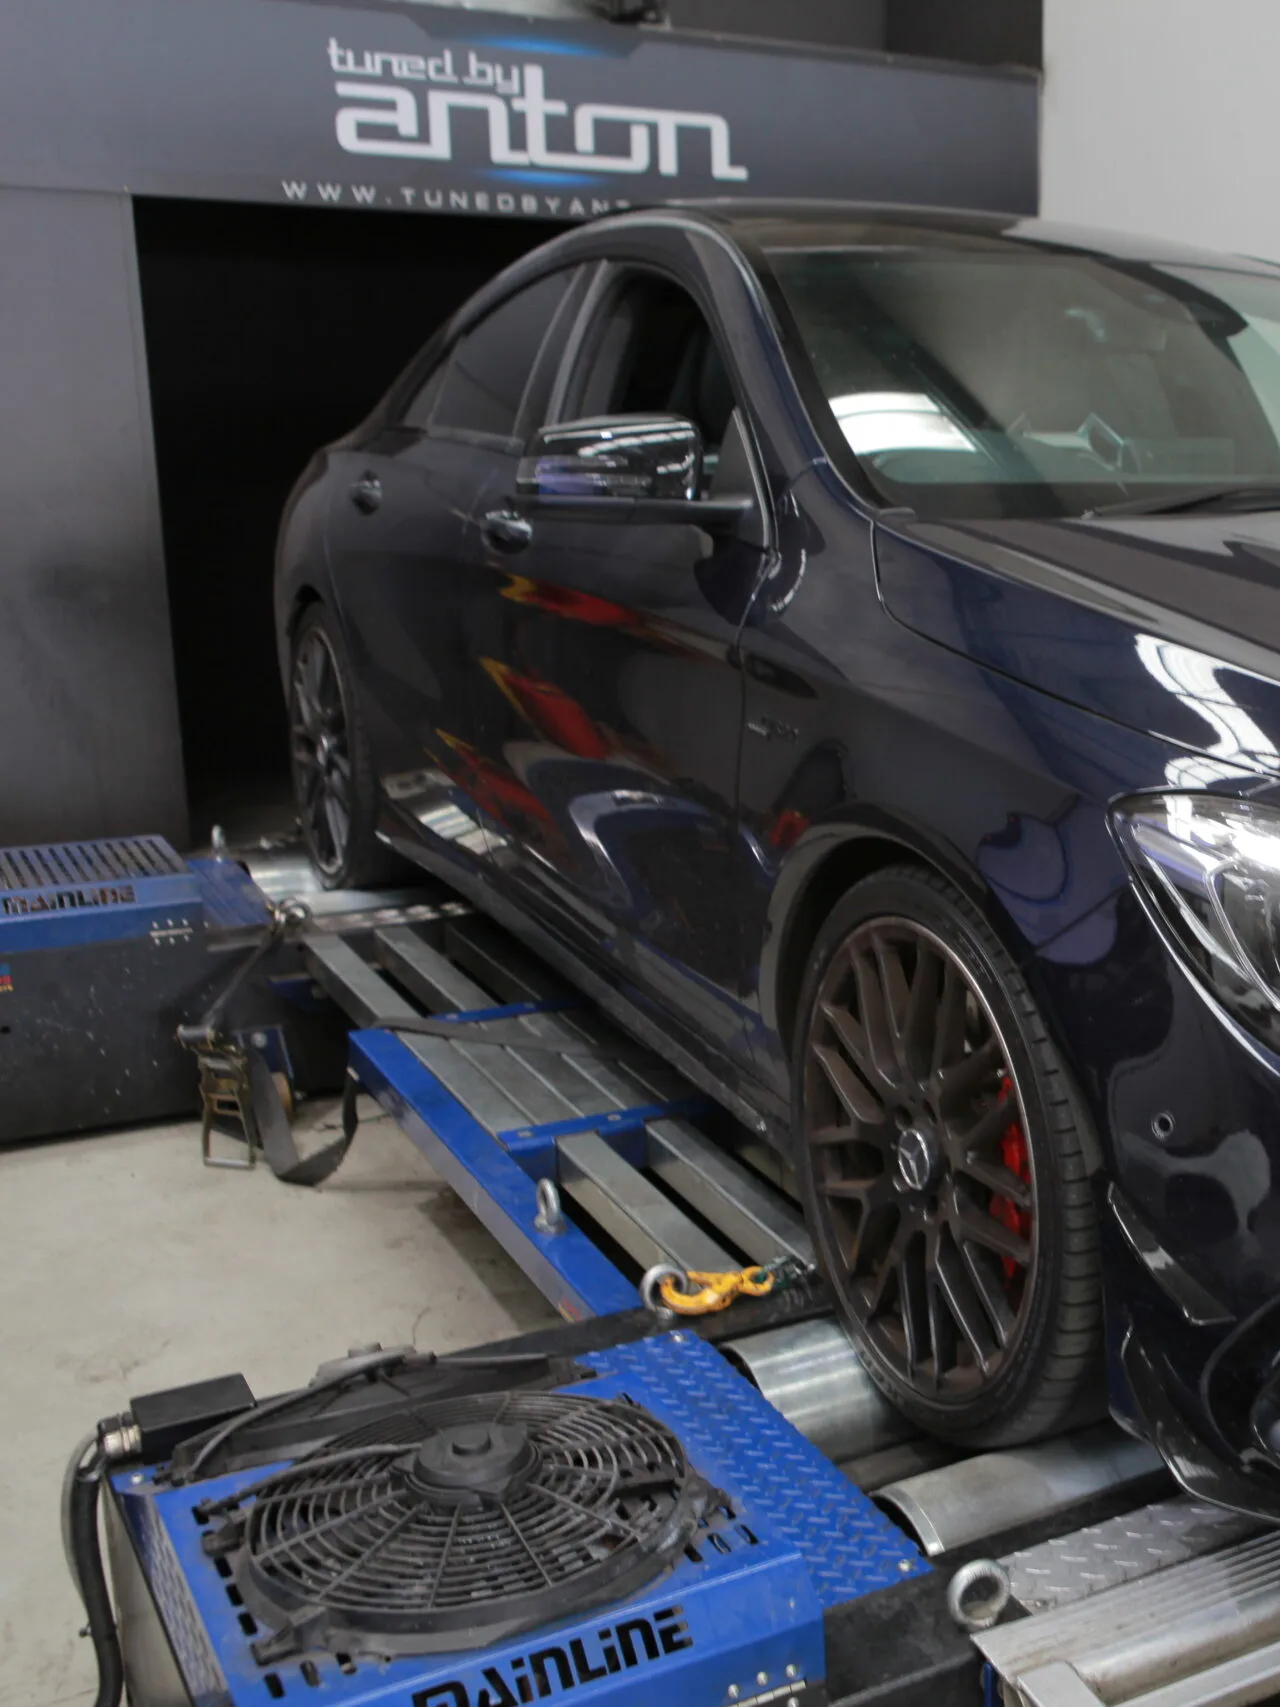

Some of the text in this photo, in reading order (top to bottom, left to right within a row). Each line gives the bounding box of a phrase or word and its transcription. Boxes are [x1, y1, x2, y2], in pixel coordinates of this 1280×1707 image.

[326, 37, 521, 95] tuned by
[334, 63, 749, 182] anton
